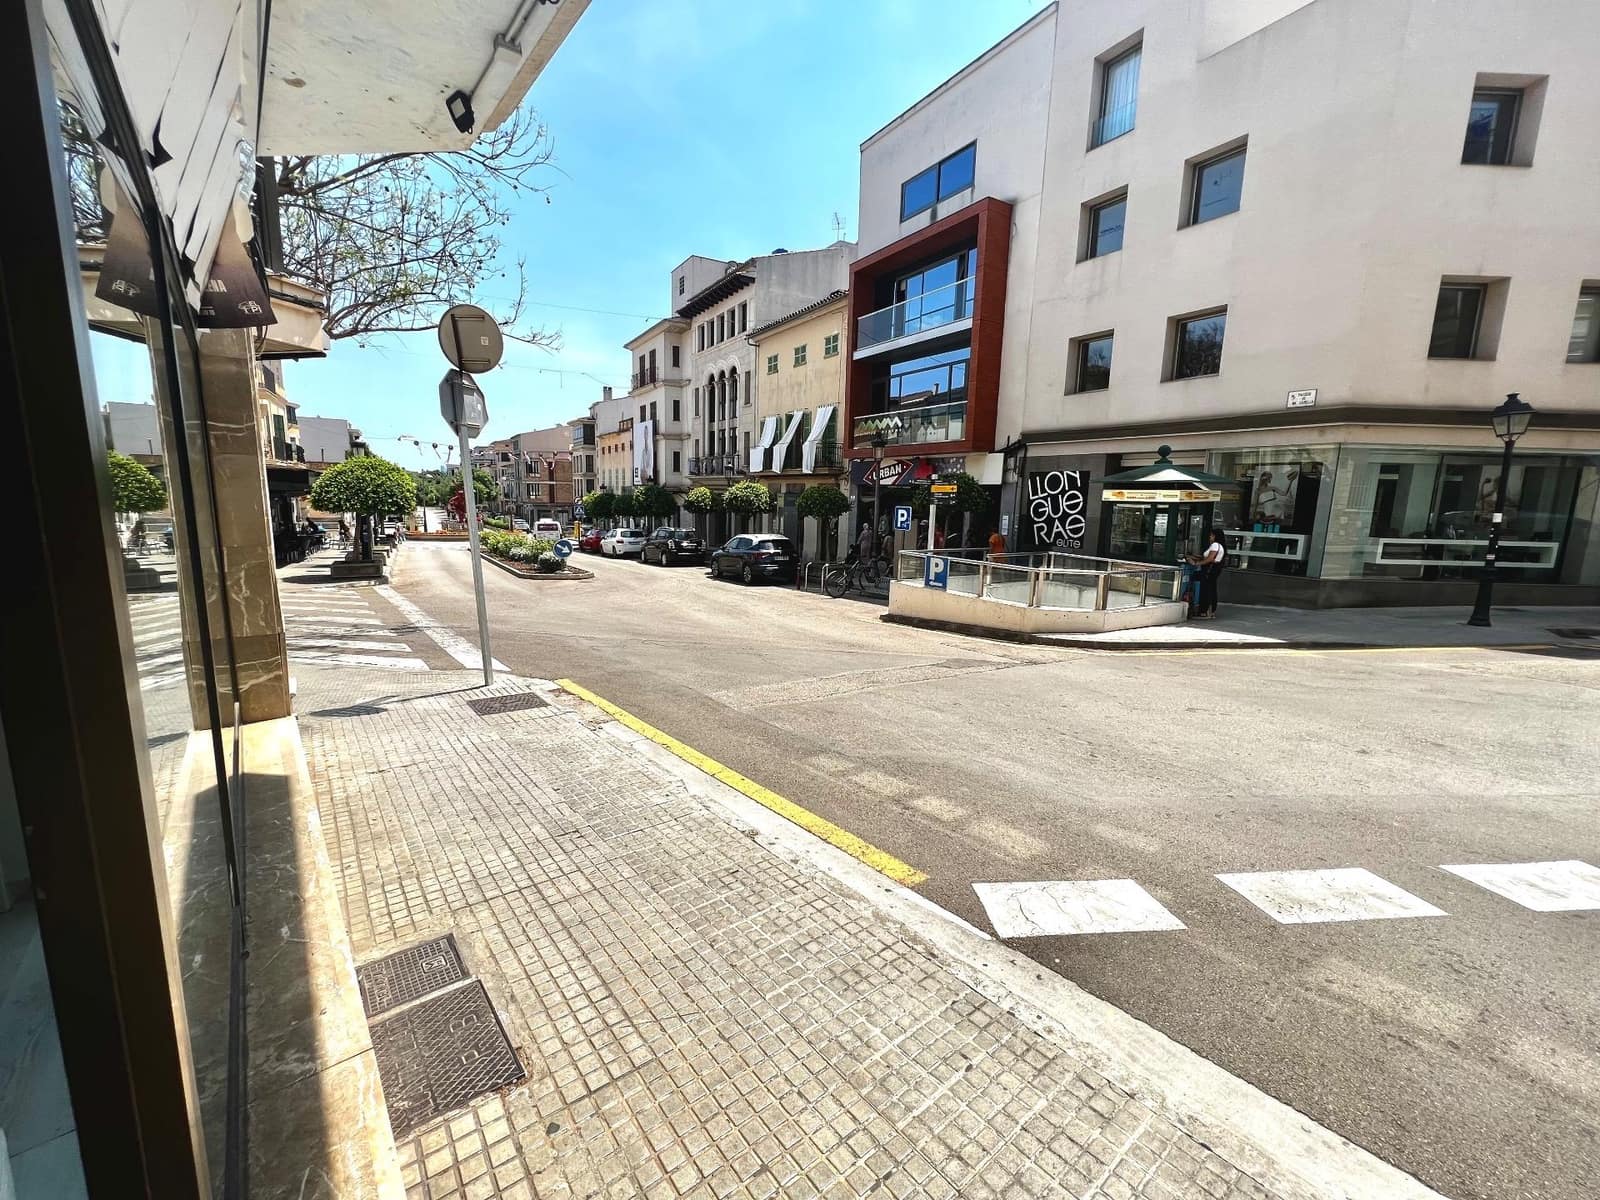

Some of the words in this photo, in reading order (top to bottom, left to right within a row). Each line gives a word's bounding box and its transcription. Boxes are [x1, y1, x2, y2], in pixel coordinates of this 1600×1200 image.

[873, 463, 902, 480] URBAN
[1028, 470, 1081, 500] LLON
[897, 509, 908, 527] P
[929, 558, 944, 580] P
